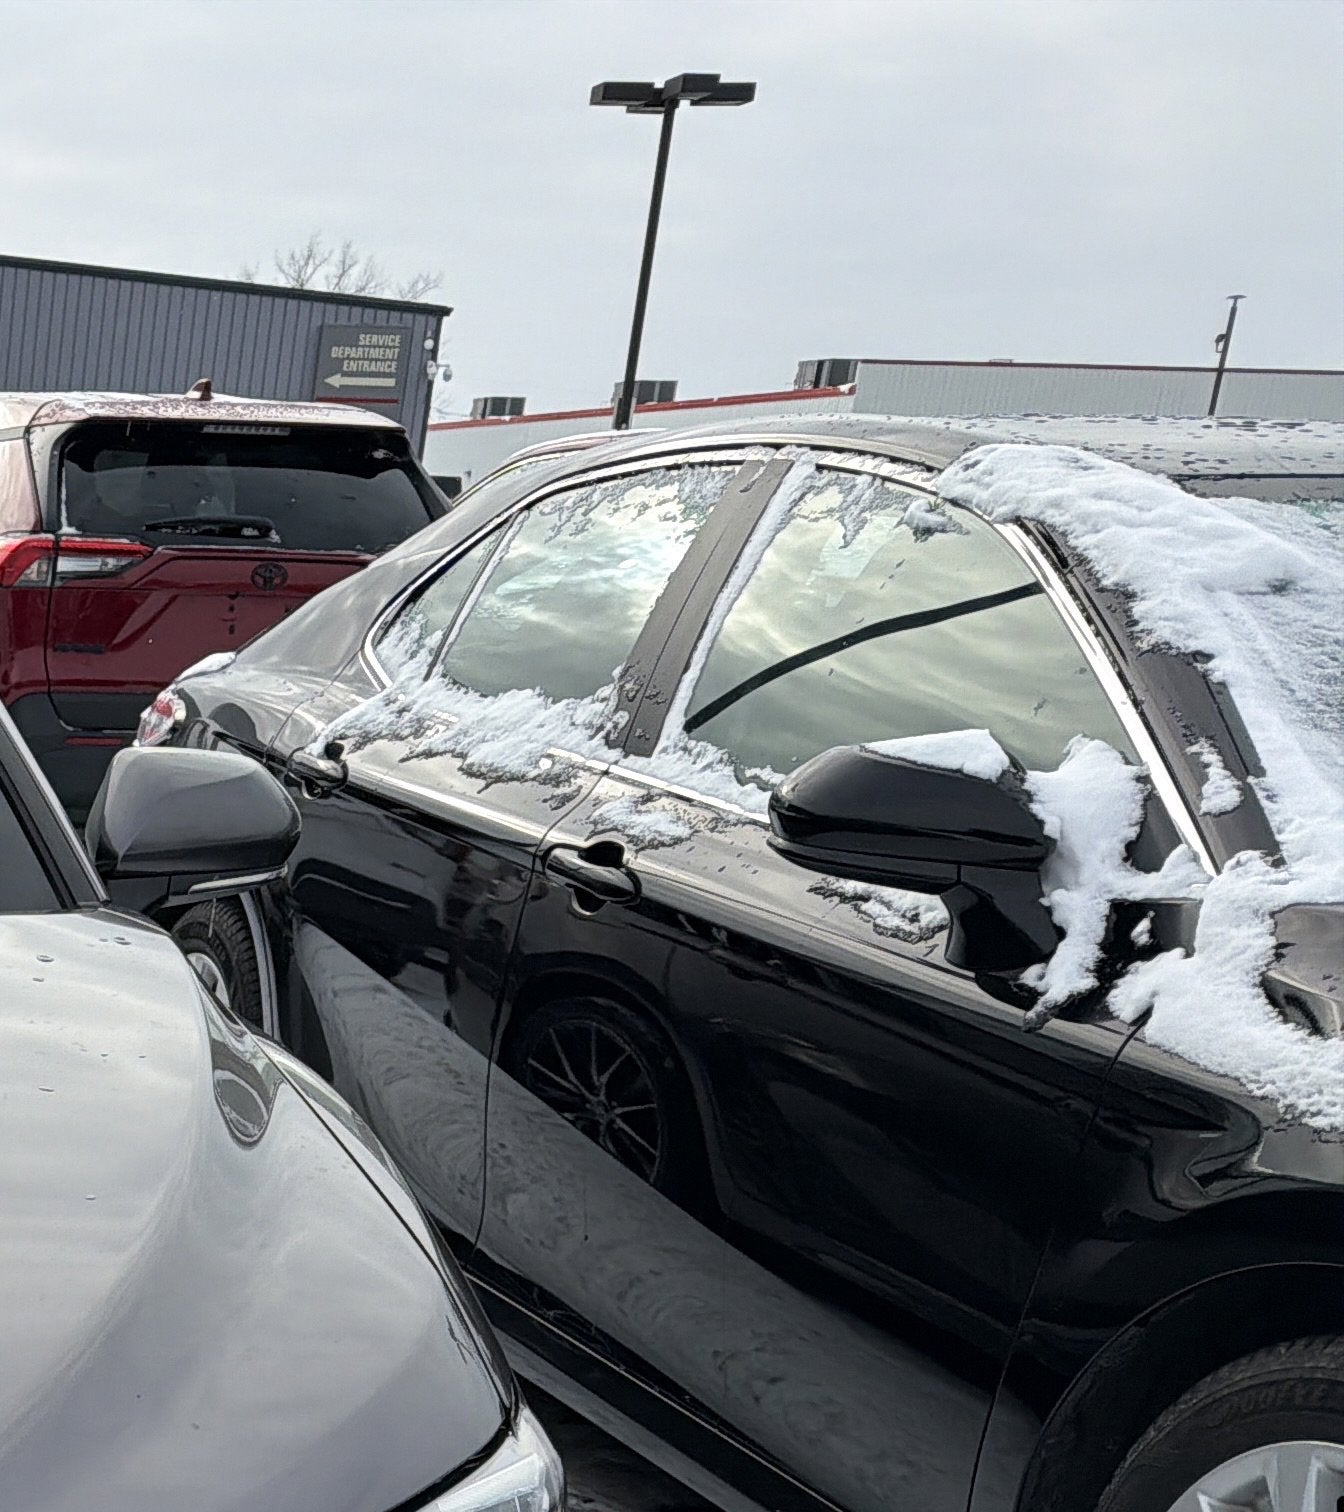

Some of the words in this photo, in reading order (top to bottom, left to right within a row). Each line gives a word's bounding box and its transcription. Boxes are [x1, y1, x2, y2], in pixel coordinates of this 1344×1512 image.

[358, 333, 401, 346] SERVICE
[331, 346, 400, 360] DEPARTMENT
[342, 360, 398, 373] ENTRANCE
